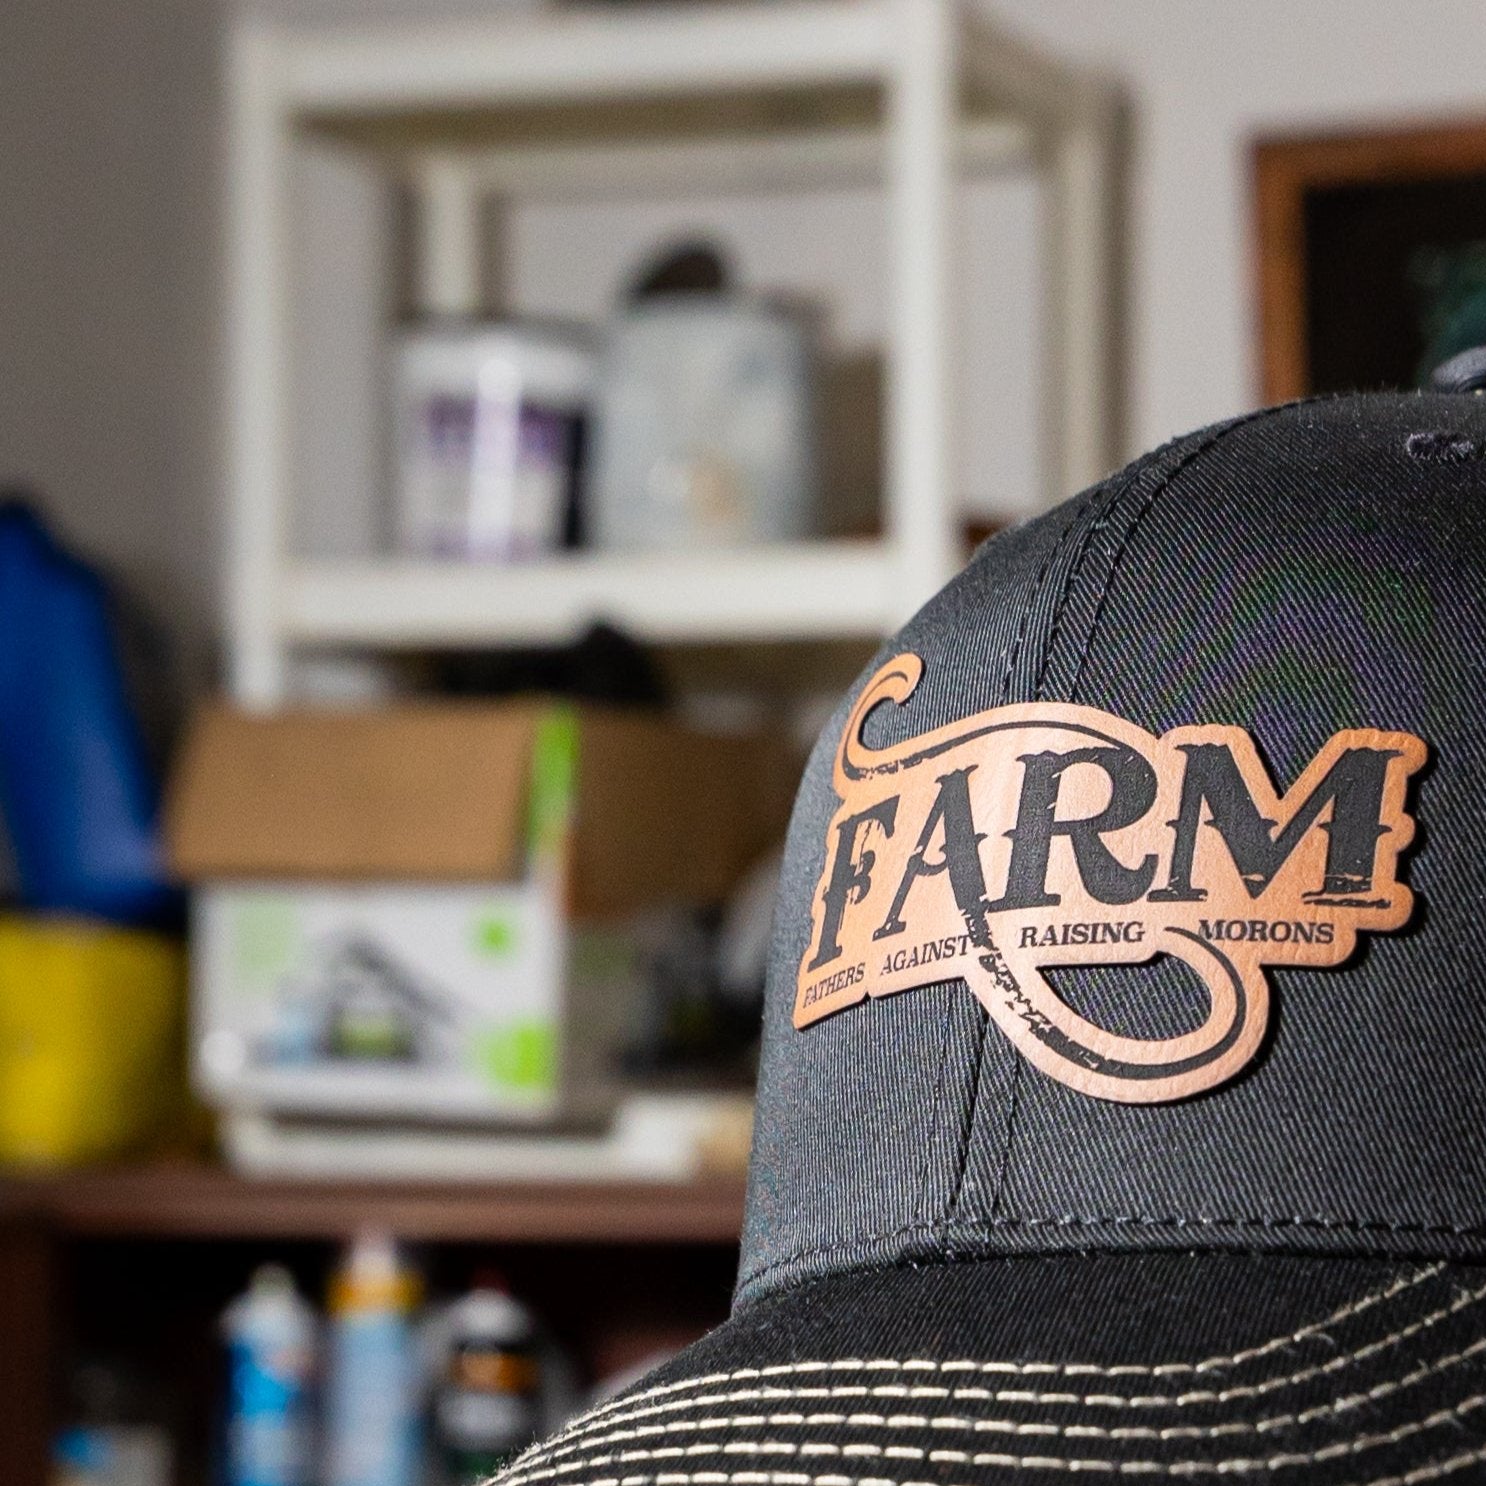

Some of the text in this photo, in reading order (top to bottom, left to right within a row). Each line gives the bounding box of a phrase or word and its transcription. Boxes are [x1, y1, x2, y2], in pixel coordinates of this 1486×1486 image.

[808, 743, 1403, 972] FARM
[803, 918, 1335, 1008] FATHERS AGAINST RAISING MORONS
